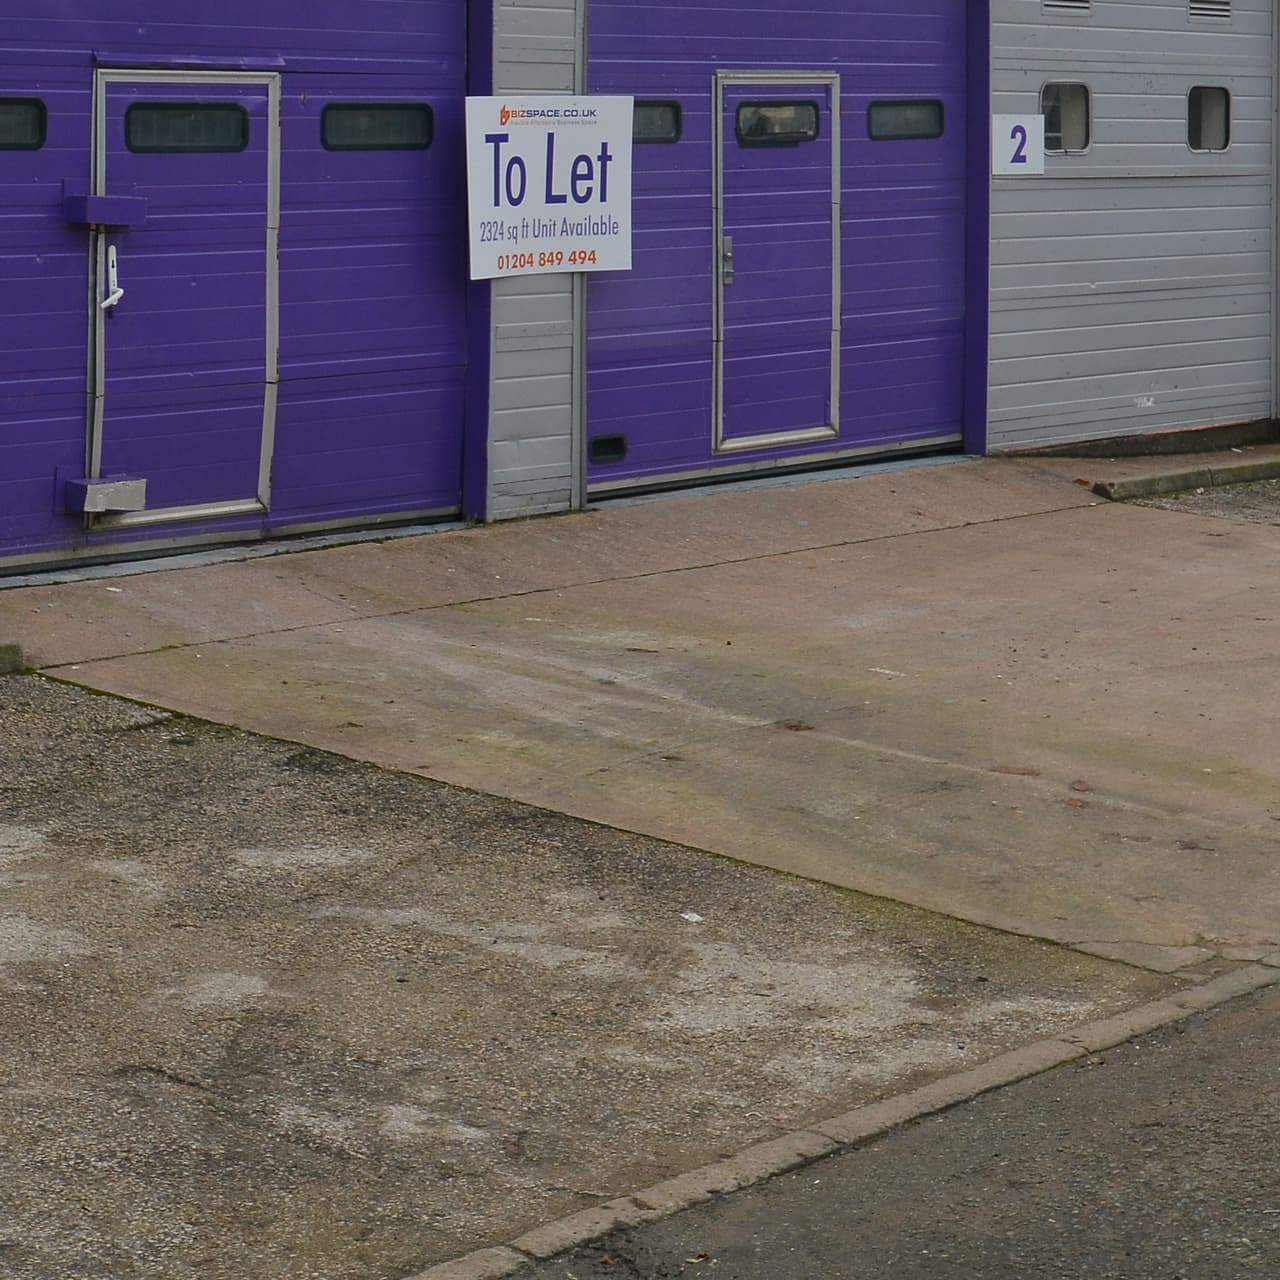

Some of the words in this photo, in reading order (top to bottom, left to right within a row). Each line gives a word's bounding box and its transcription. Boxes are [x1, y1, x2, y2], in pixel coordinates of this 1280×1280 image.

[511, 109, 597, 118] BIZSPACE.CO.UK
[1010, 125, 1027, 164] 2
[485, 133, 527, 208] To
[545, 132, 613, 205] Let
[480, 221, 505, 242] 2324
[507, 225, 518, 245] sq
[521, 218, 529, 239] ft
[533, 218, 557, 238] Unit
[560, 215, 619, 237] Available
[498, 253, 534, 270] 01204
[538, 251, 564, 267] 849
[568, 250, 597, 264] 494
